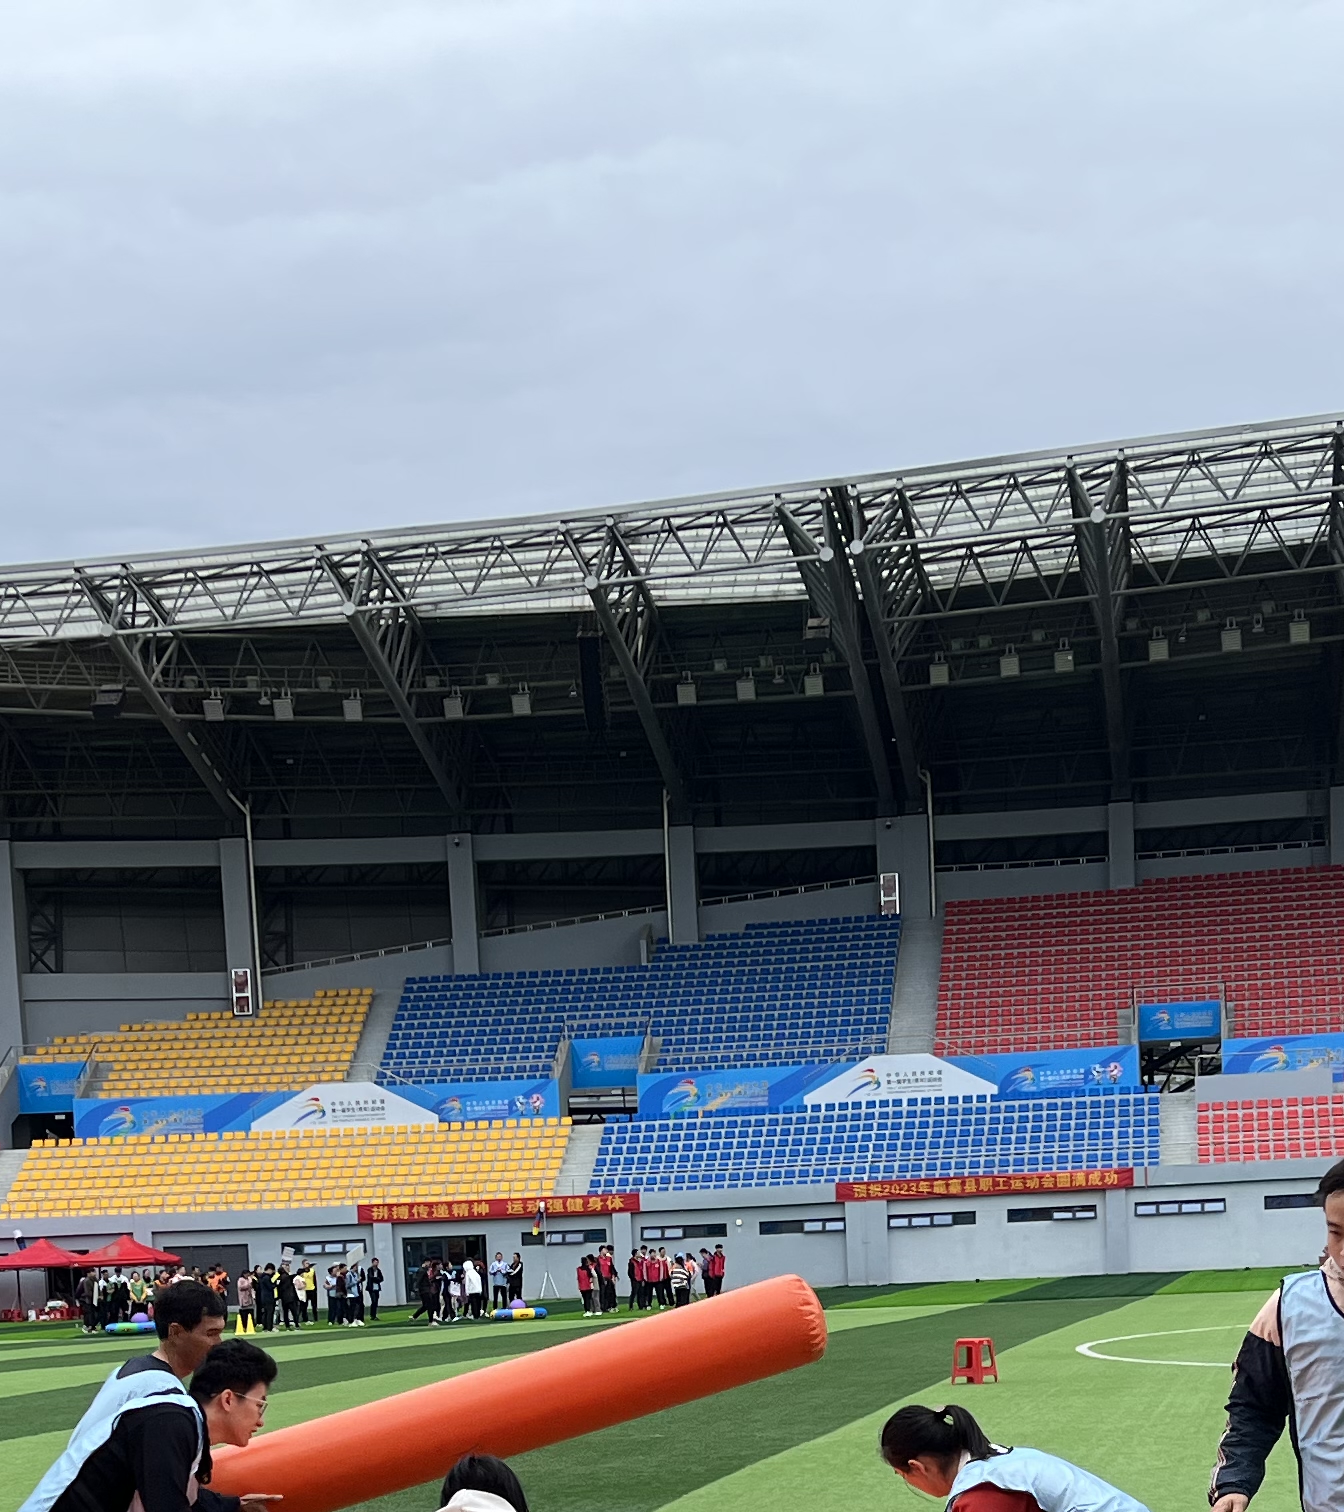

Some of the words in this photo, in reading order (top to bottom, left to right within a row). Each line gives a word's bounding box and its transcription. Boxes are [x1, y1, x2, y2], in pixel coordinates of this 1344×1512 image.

[372, 1201, 490, 1220] 拼搏传递精神
[506, 1195, 624, 1215] 运动强健身体
